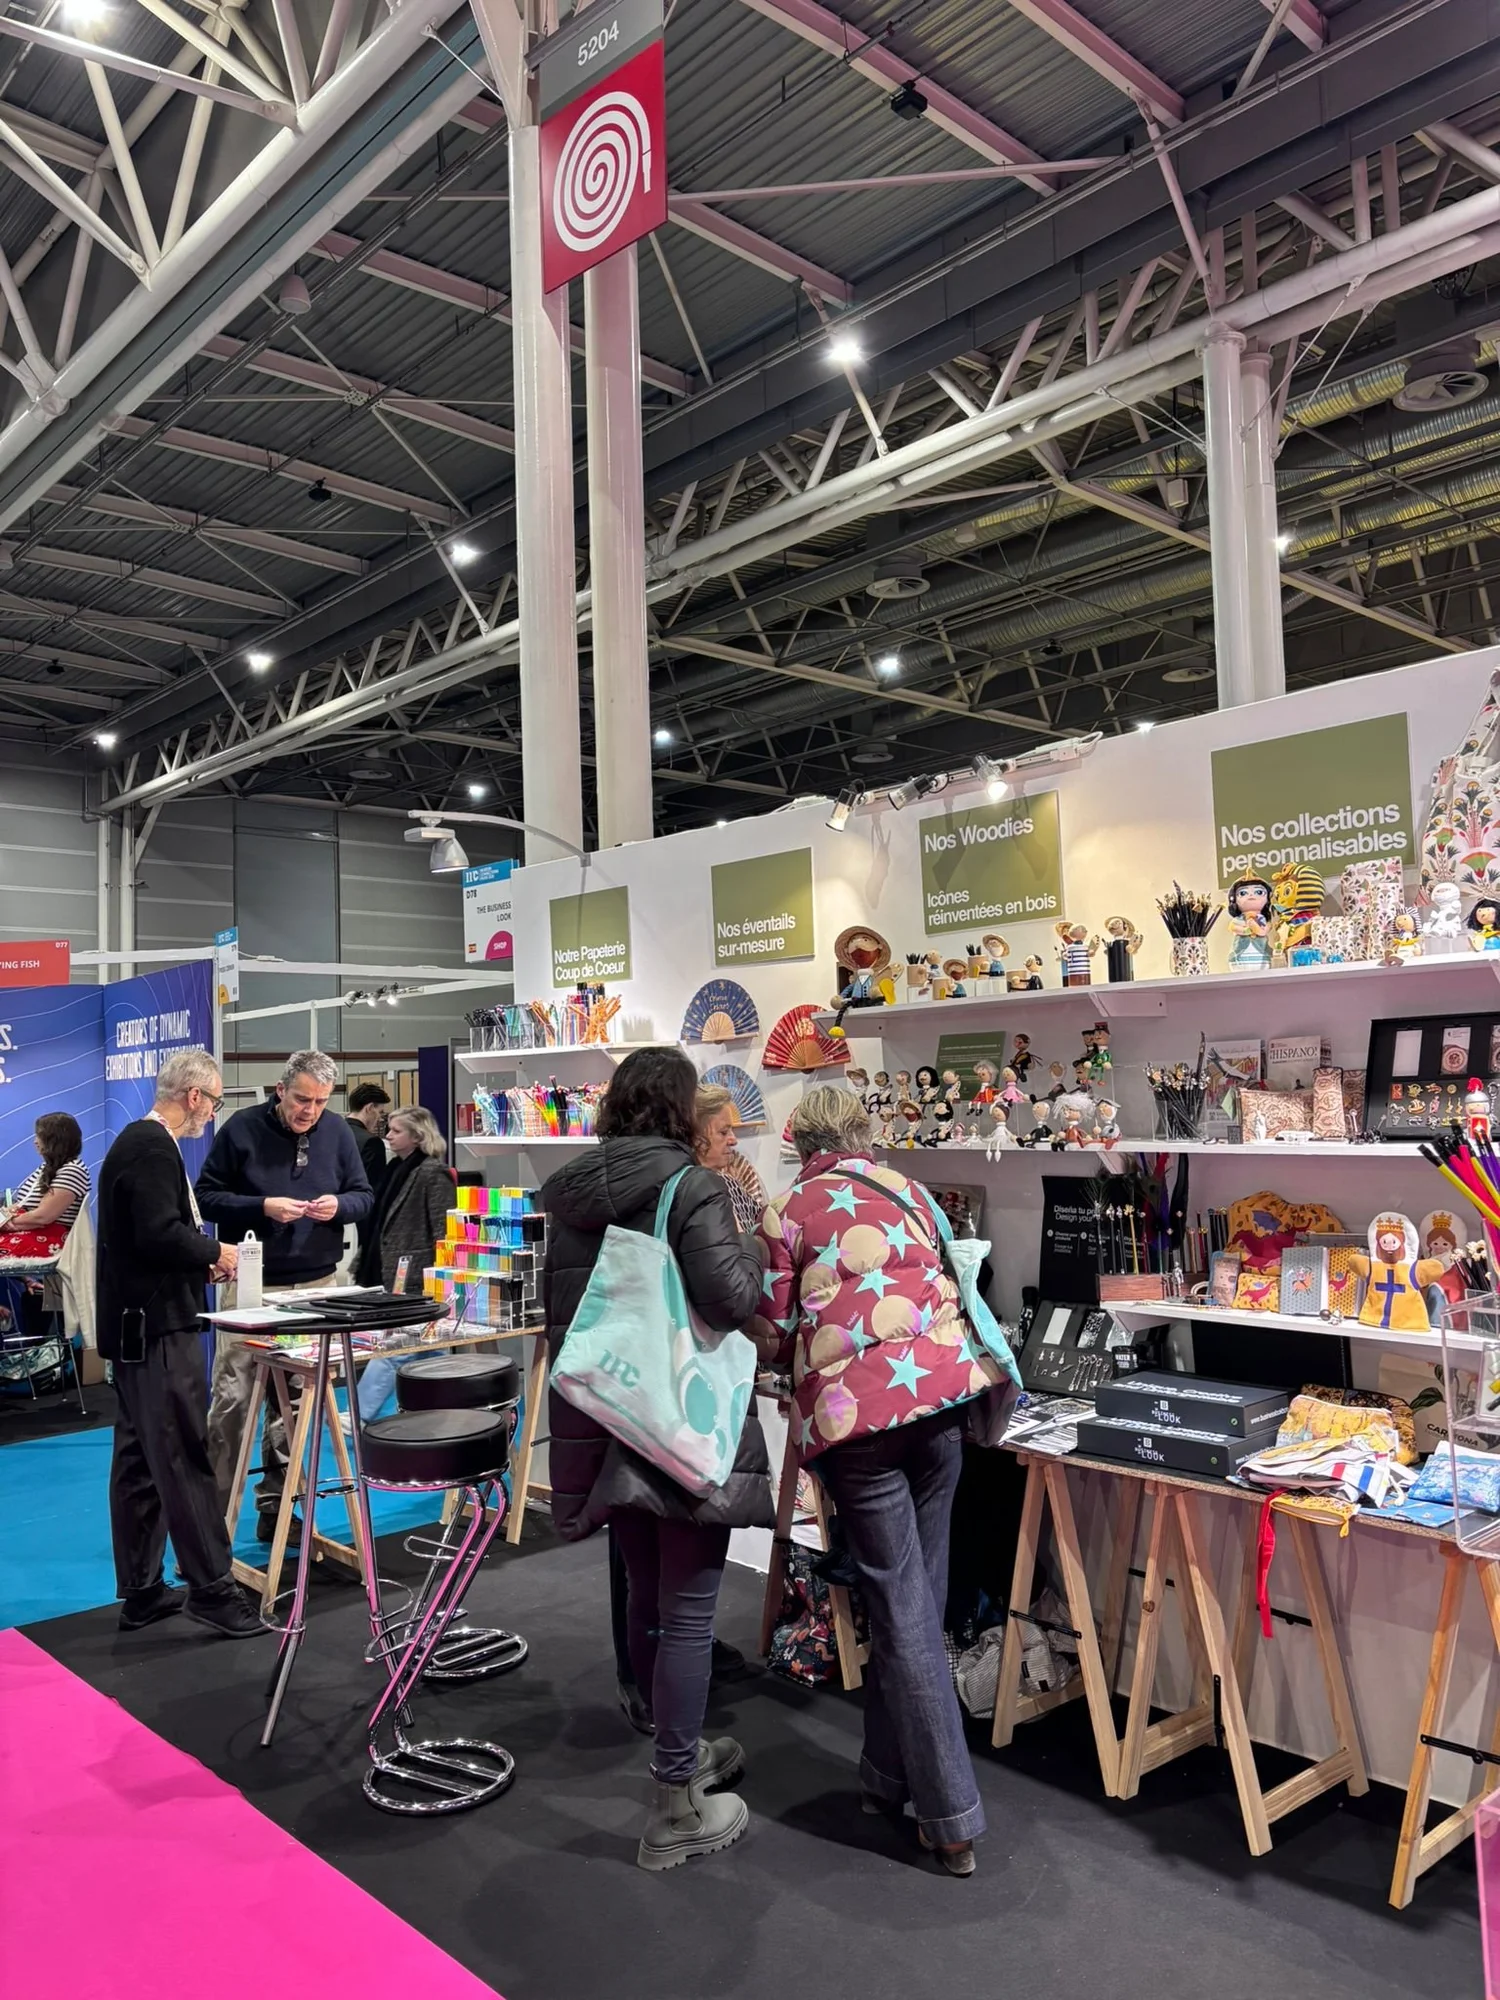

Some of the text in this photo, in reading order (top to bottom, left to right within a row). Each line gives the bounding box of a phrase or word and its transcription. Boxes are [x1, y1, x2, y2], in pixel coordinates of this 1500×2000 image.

[578, 21, 618, 66] 5204
[924, 815, 1034, 853] Nos Woodies
[1219, 803, 1401, 849] Nos collections
[1221, 829, 1408, 878] personnalisables
[466, 889, 477, 899] D78
[926, 887, 970, 909] Icônes
[476, 901, 511, 914] THE BUSINESS
[497, 913, 512, 922] LOOK
[928, 892, 1057, 927] réinventées en bois
[716, 912, 796, 938] Nos éventails
[493, 941, 507, 951] SHOP
[554, 941, 626, 964] Notre Papeterie
[717, 936, 785, 959] sur-mesure
[20, 960, 40, 969] FISH
[555, 960, 626, 983] Coup de Coeur
[149, 1015, 158, 1043] OF
[160, 1009, 191, 1042] DYNAMIC
[143, 1049, 158, 1078] AND
[1157, 1413, 1181, 1425] LOOK
[1141, 1449, 1165, 1462] LOOK
